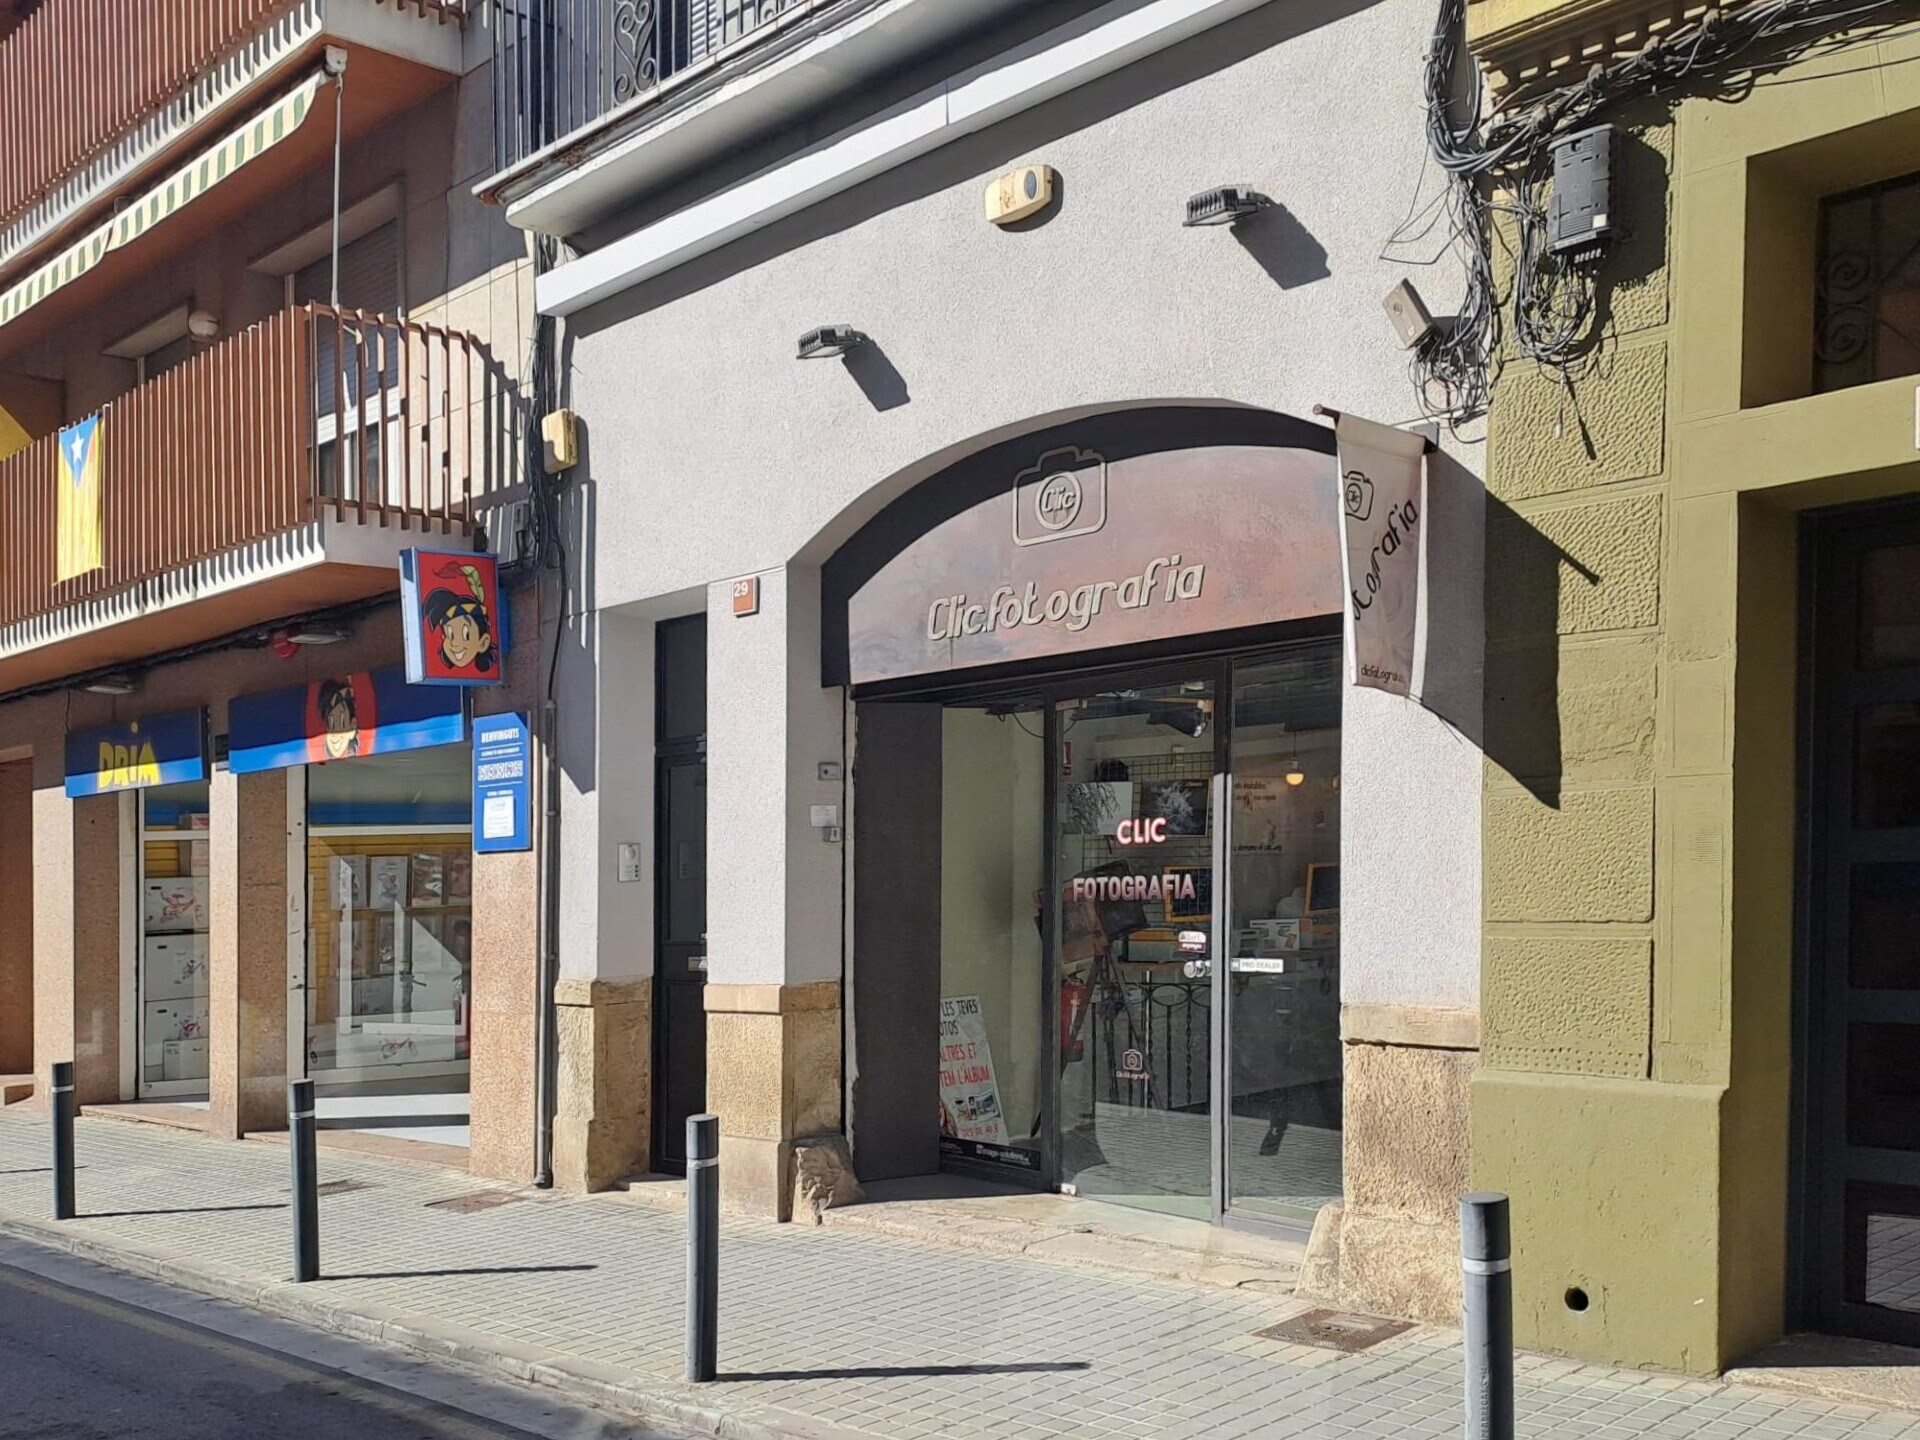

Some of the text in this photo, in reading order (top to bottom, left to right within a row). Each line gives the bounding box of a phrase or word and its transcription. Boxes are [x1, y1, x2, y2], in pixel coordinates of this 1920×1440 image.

[1041, 486, 1076, 513] Clic
[734, 581, 748, 597] 29
[1116, 817, 1167, 845] CLIC
[1073, 873, 1196, 902] FOTOGRAFIA
[956, 999, 979, 1016] TEVES
[967, 1042, 977, 1060] ET
